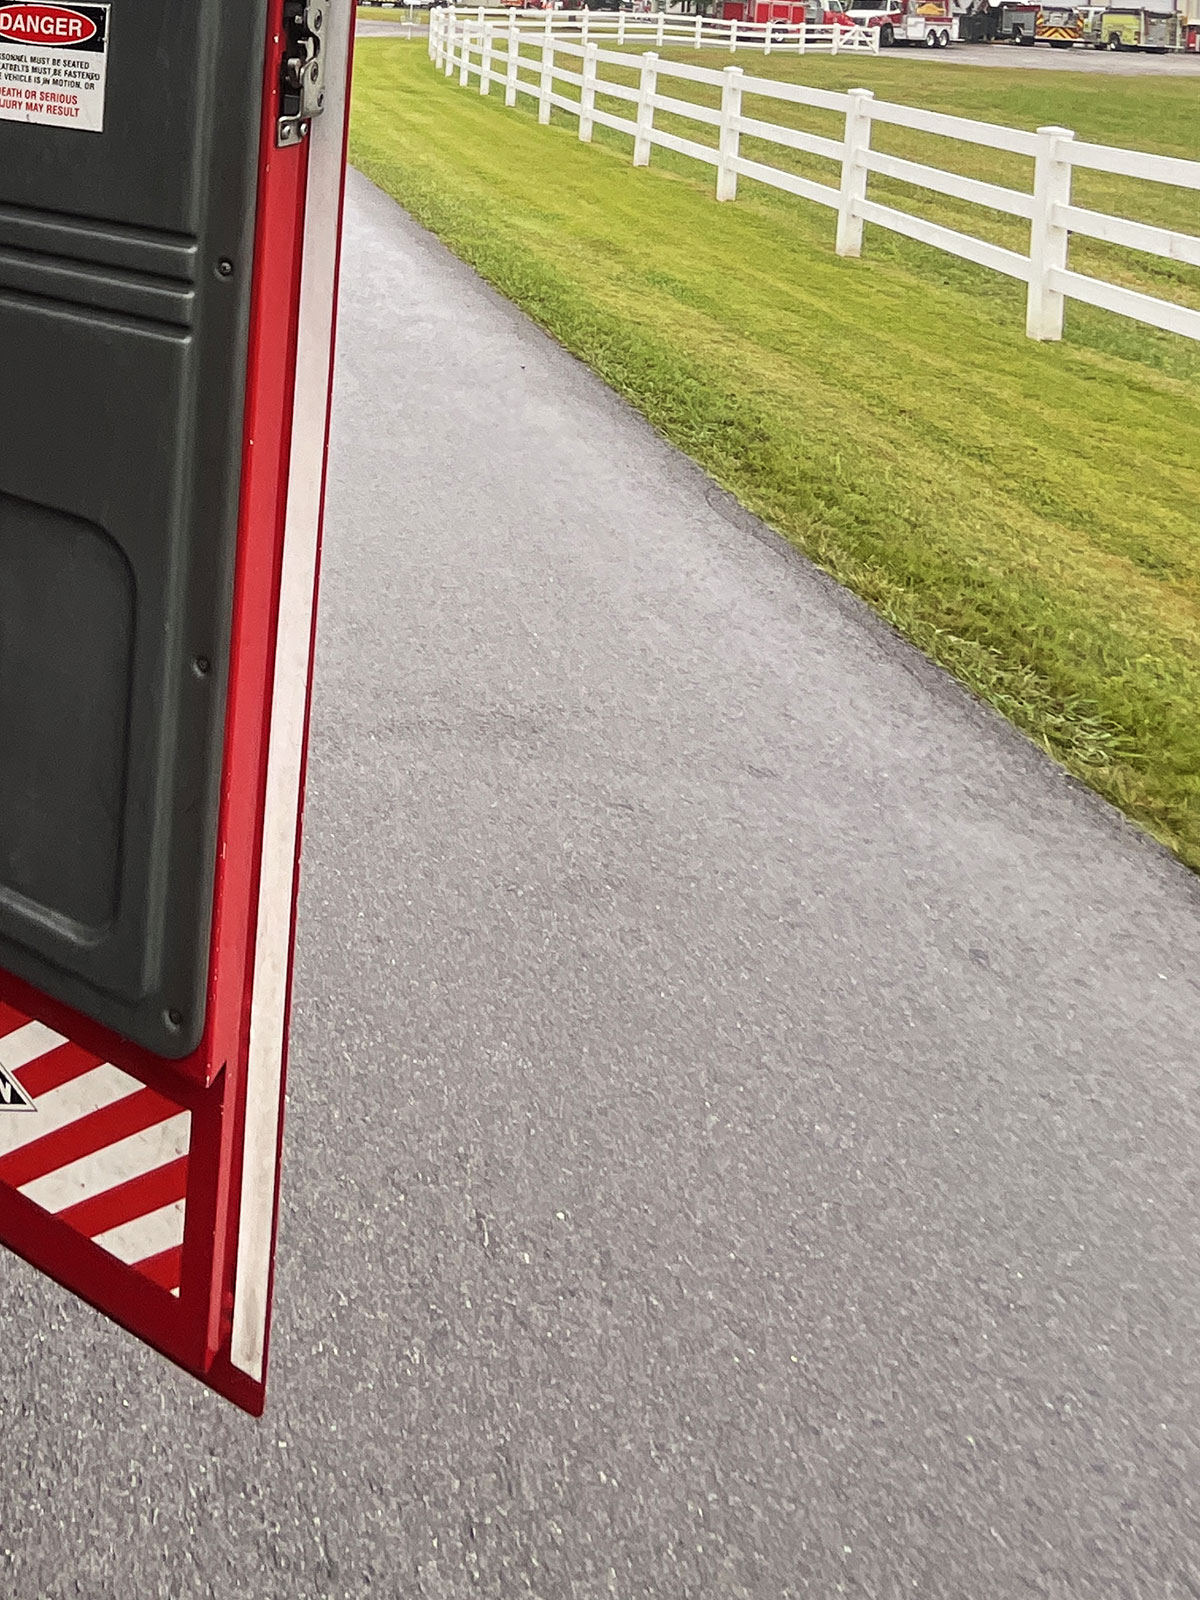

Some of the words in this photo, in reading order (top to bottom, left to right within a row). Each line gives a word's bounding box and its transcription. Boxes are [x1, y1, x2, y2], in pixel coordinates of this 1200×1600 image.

[0, 13, 82, 37] DANGER
[30, 56, 50, 65] MUST
[52, 58, 61, 66] BE
[63, 60, 90, 69] SEATED
[4, 73, 32, 83] VEHICLE
[33, 76, 40, 84] IS
[42, 77, 50, 85] IN
[84, 82, 95, 90] OR
[31, 66, 51, 75] MUST
[52, 68, 61, 77] BE
[64, 69, 100, 81] FASTENED
[24, 89, 37, 100] OR
[39, 91, 78, 105] SERIOUS
[25, 101, 44, 112] MAY
[46, 104, 80, 117] RESULT
